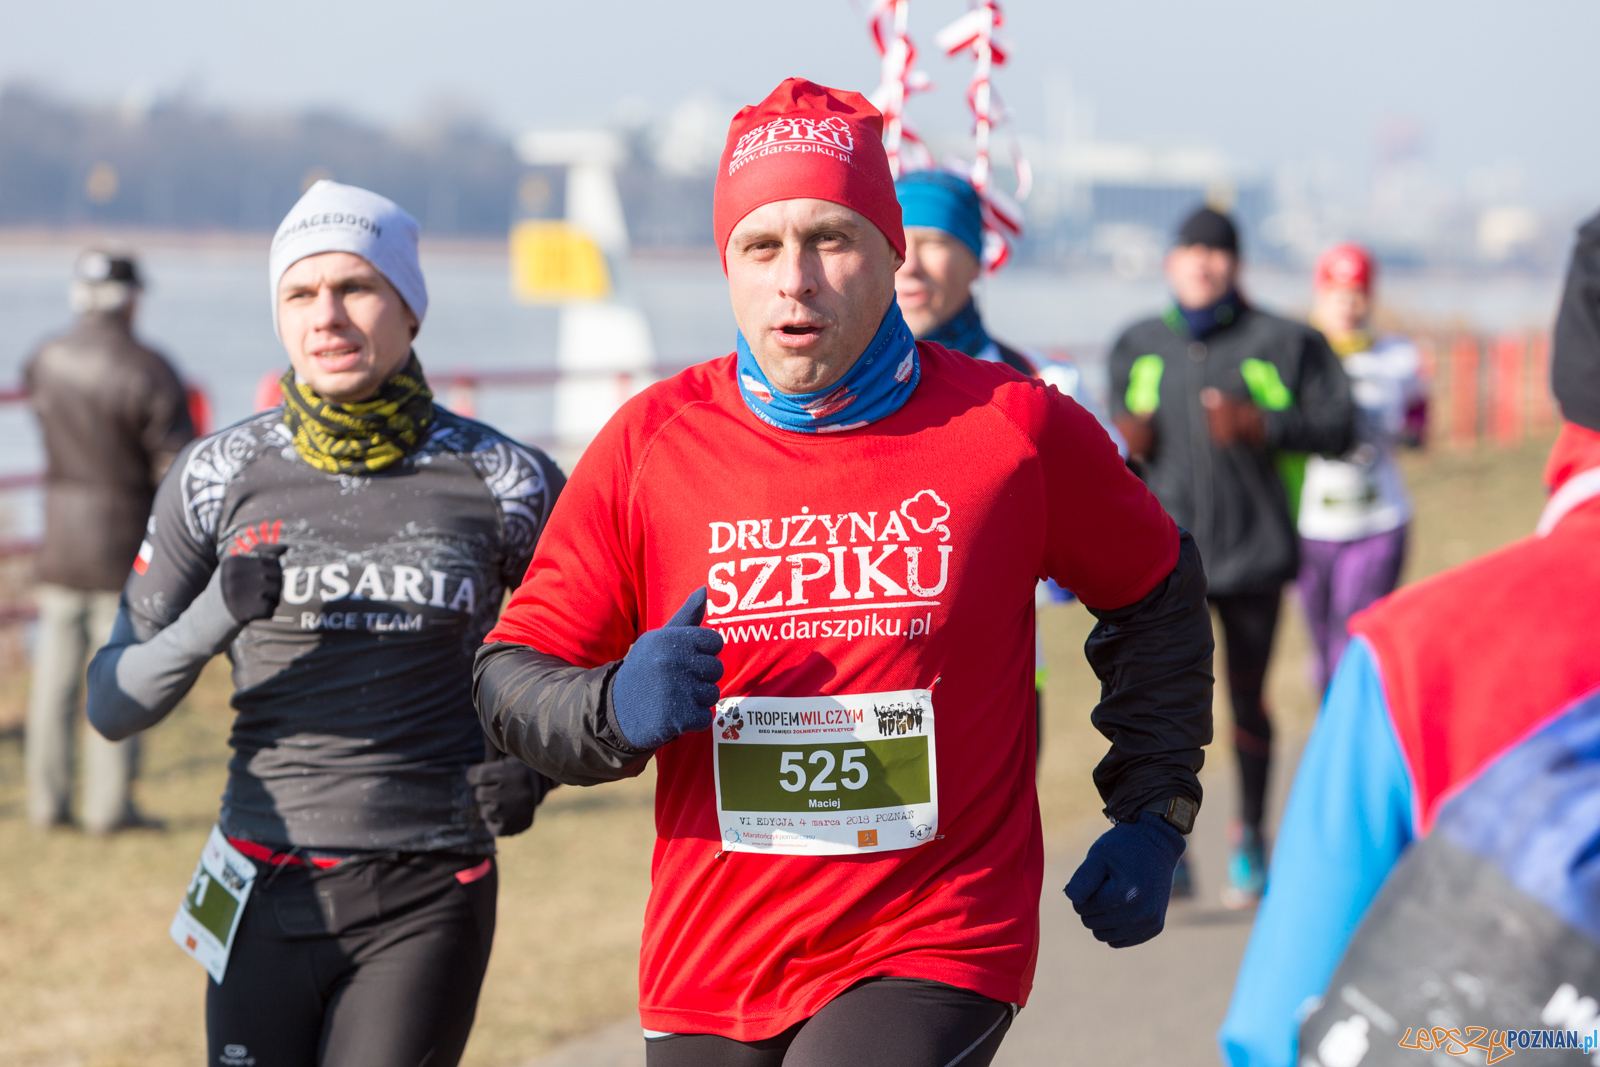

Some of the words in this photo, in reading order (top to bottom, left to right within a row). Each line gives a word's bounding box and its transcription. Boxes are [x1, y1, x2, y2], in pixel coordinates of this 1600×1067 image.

[729, 124, 854, 168] SZPIKU
[736, 117, 829, 148] DRUŻYNA
[728, 143, 850, 176] www.darszpiku.pl
[708, 506, 910, 554] DRUŻYNA
[283, 562, 476, 612] USARIA
[706, 544, 953, 616] SZPIKU
[301, 611, 358, 630] RACE
[365, 612, 423, 631] TEAM
[779, 748, 869, 793] 525
[757, 817, 795, 827] EDYCJA
[799, 817, 807, 827] 4
[812, 818, 841, 827] marca
[846, 815, 870, 826] 2018
[875, 810, 915, 823] POZNAŃ
[808, 798, 841, 809] Maciej
